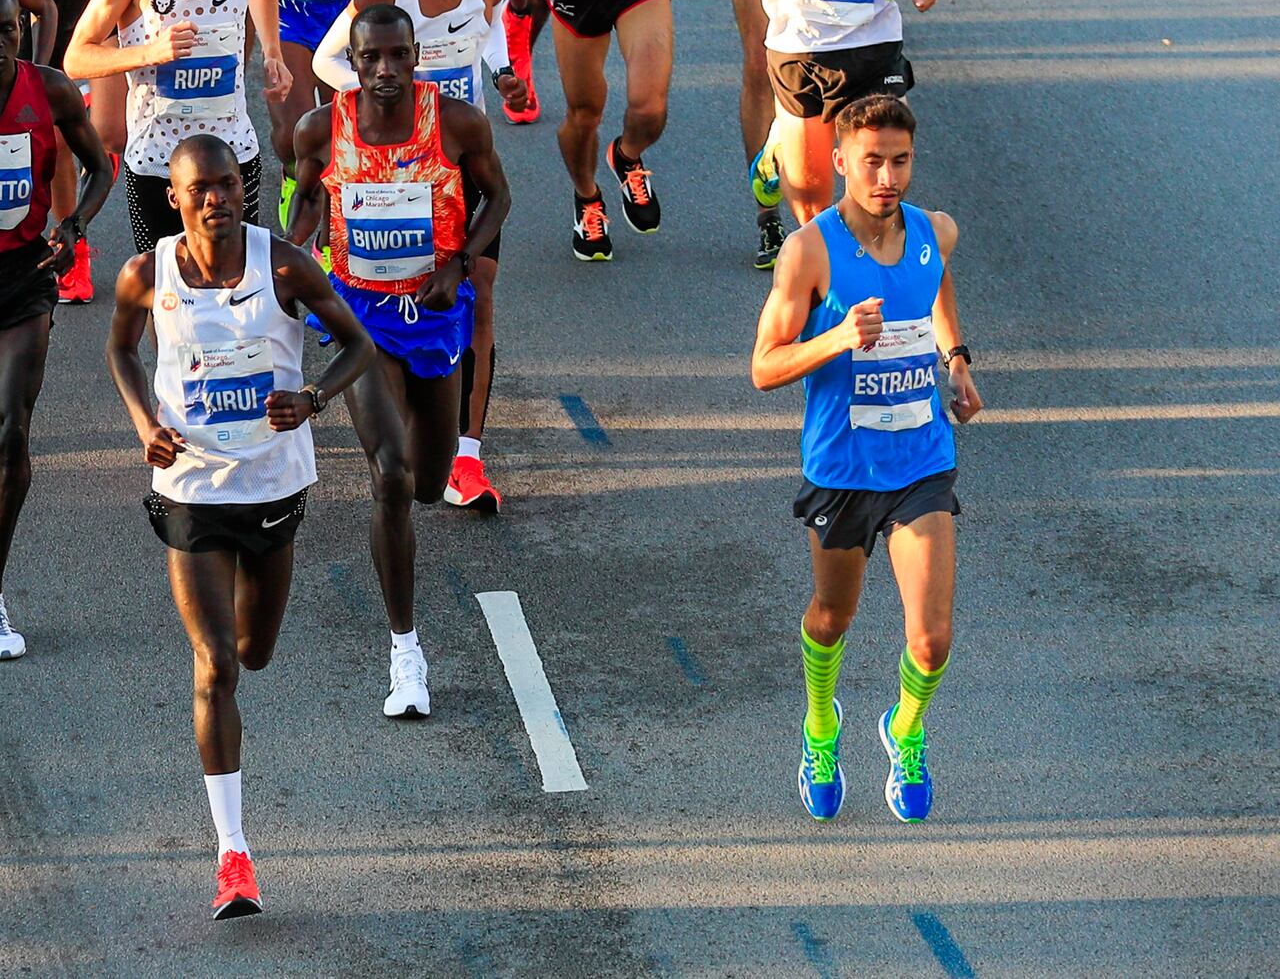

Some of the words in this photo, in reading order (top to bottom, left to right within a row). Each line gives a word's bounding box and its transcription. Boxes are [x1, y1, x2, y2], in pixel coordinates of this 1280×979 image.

[174, 68, 222, 90] RUPP
[352, 229, 425, 252] BIWOTT
[853, 365, 936, 395] ESTRADA
[204, 390, 258, 413] KIRUI
